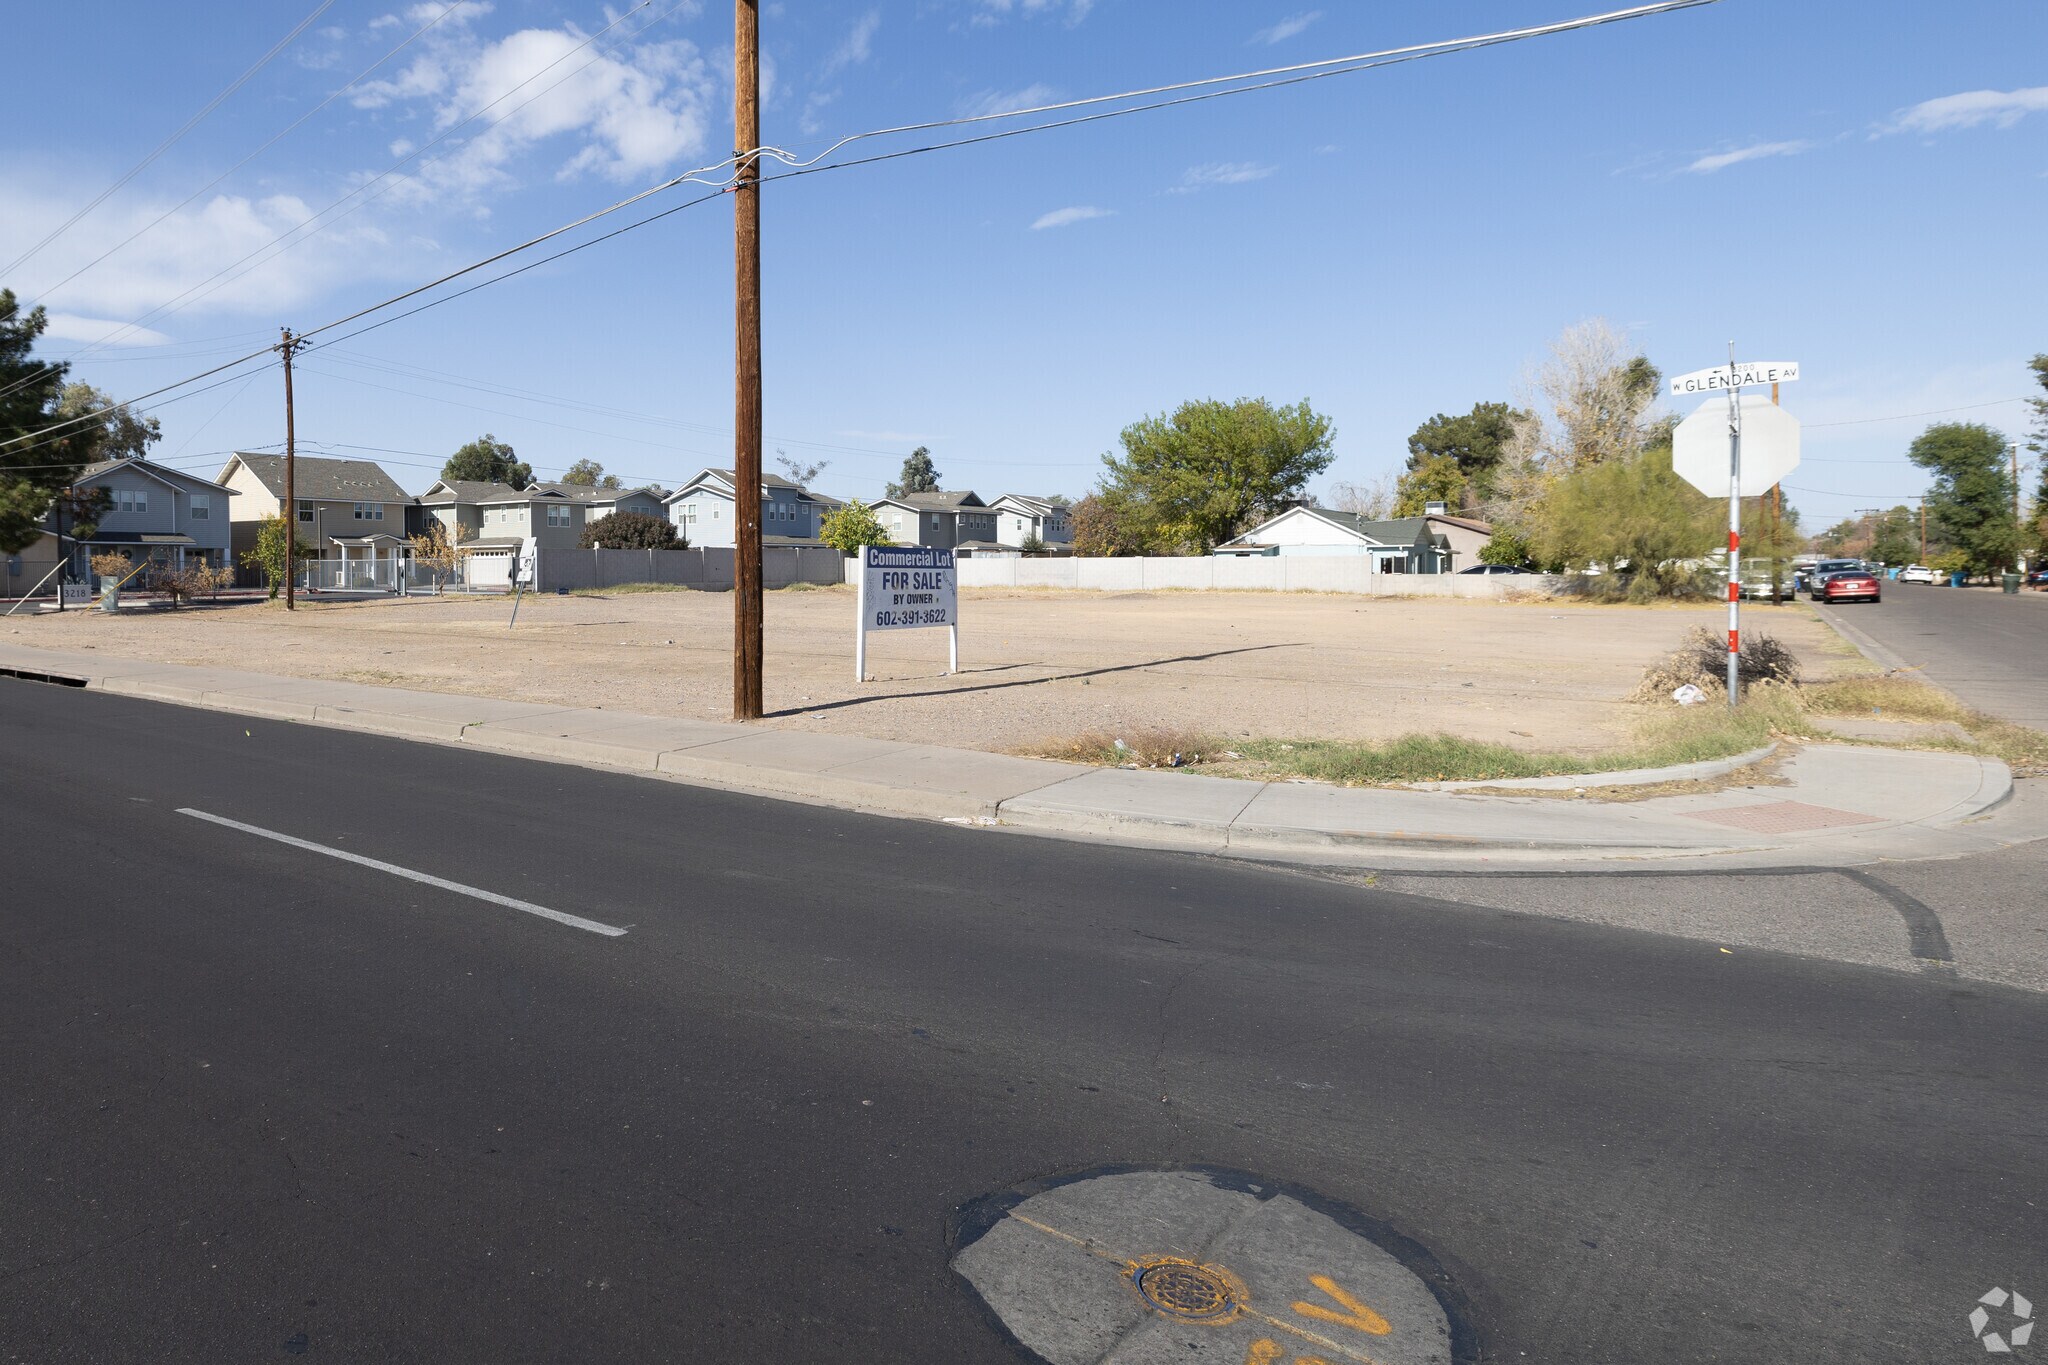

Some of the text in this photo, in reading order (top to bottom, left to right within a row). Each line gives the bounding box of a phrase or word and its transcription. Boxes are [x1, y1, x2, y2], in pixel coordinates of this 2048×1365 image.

[1673, 369, 1797, 392] W GLENDALE AV
[869, 548, 951, 567] Commercial Lot
[882, 571, 909, 590] FOR
[913, 571, 942, 590] SALE
[64, 589, 86, 598] 3218
[893, 593, 933, 605] BY OWNER
[876, 608, 946, 626] 602-391-3622
